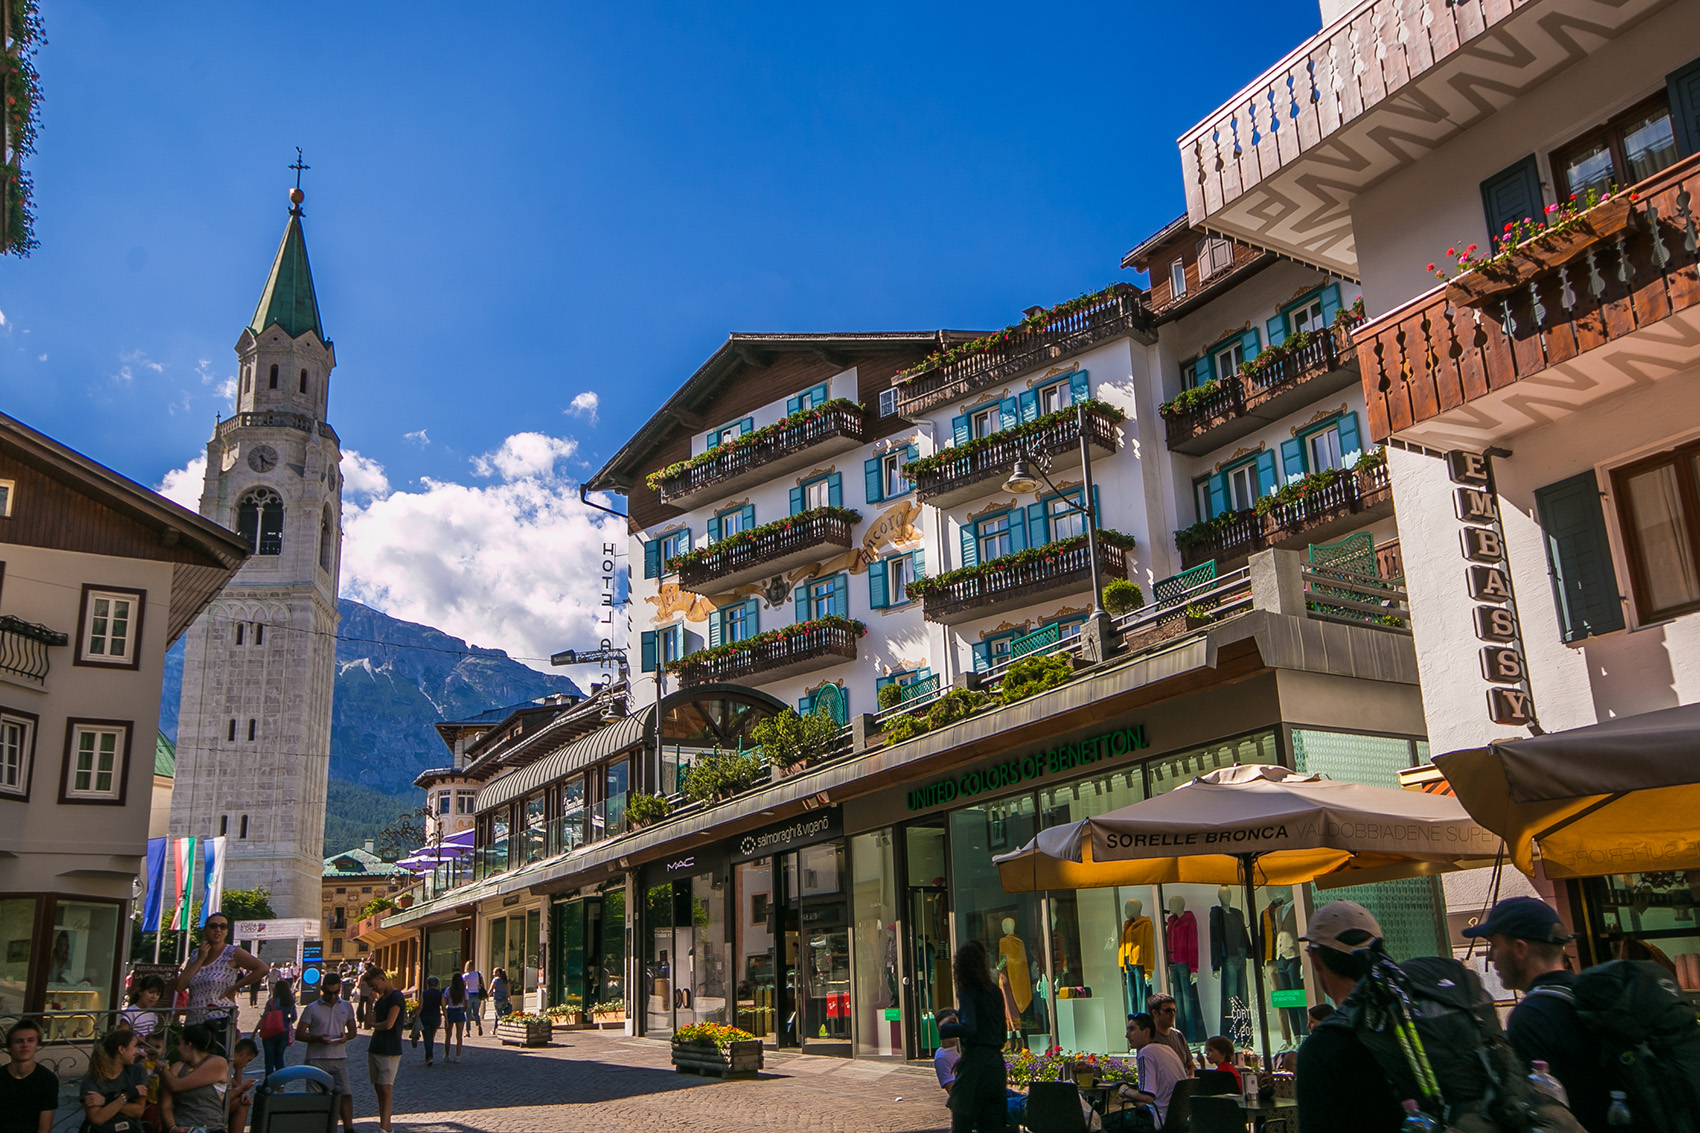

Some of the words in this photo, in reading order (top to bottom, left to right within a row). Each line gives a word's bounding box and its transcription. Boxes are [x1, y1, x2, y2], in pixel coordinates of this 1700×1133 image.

[1463, 452, 1526, 718] EMBASSY
[906, 780, 956, 811] UNITED
[957, 760, 1020, 798] COLORS
[1021, 753, 1045, 780] OF
[1106, 833, 1198, 849] SORELLE
[1205, 825, 1289, 844] BRONCA
[1296, 822, 1441, 842] VALDOBBIADENE
[666, 856, 695, 872] MAC
